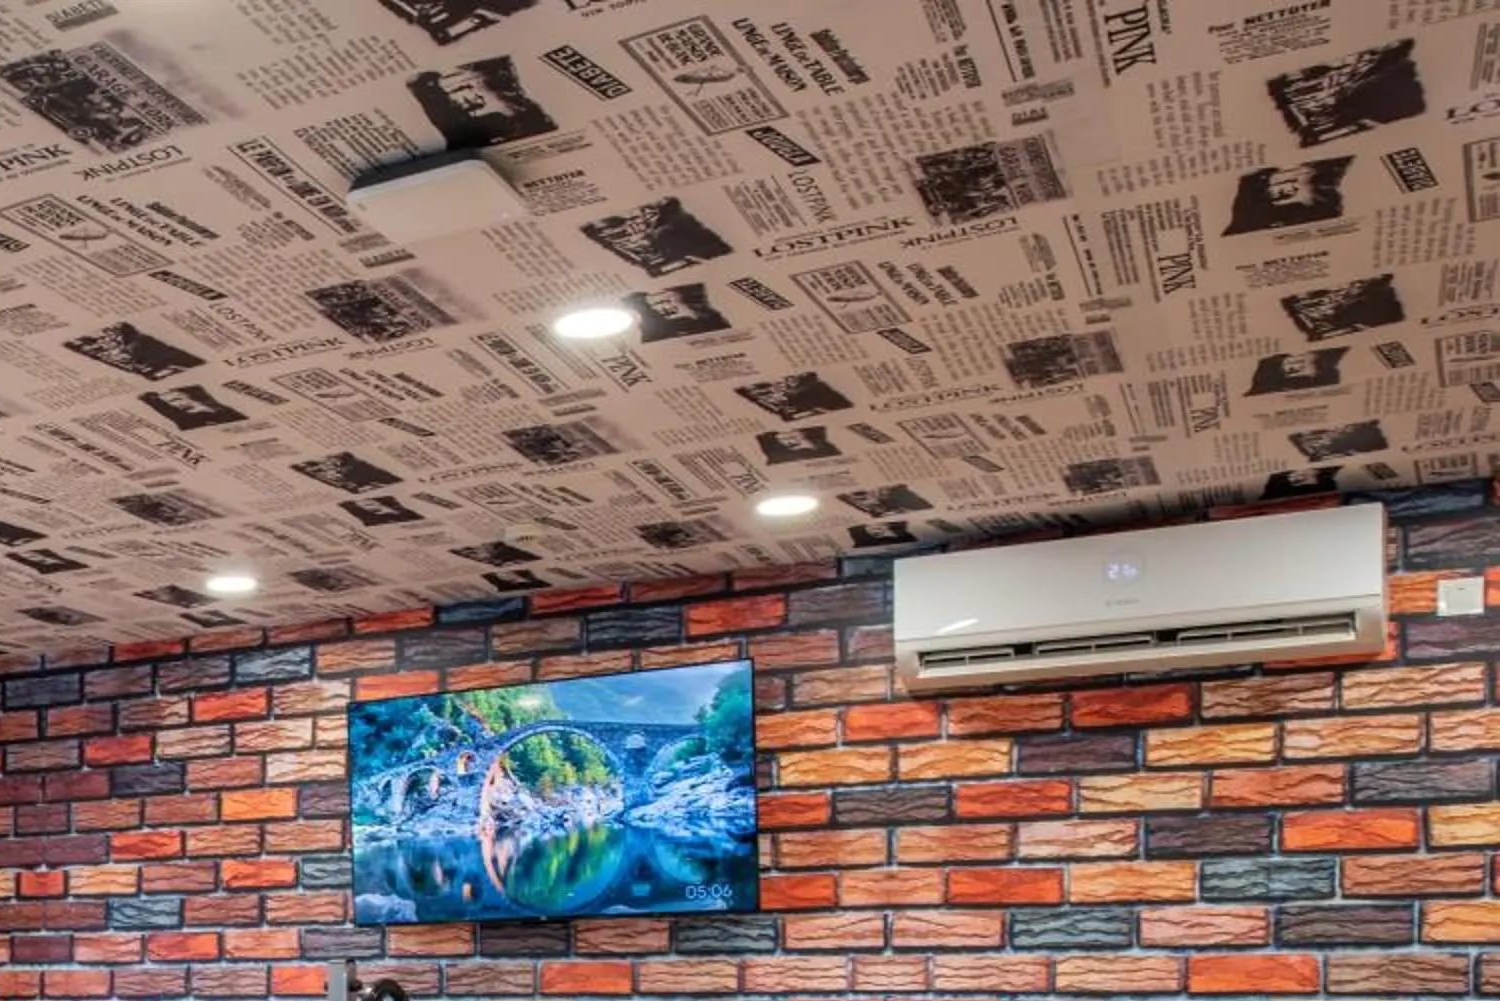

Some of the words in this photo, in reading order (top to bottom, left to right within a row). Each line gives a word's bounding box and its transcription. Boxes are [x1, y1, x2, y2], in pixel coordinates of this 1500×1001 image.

[1103, 4, 1157, 76] PINK
[547, 45, 631, 98] DIABETE
[806, 59, 846, 96] TABLE
[82, 144, 185, 182] LOSTPINK
[753, 214, 915, 259] LOSTPINK
[900, 216, 1018, 250] LOSTPINK
[1156, 251, 1197, 296] PINK
[685, 883, 733, 899] 05:06
